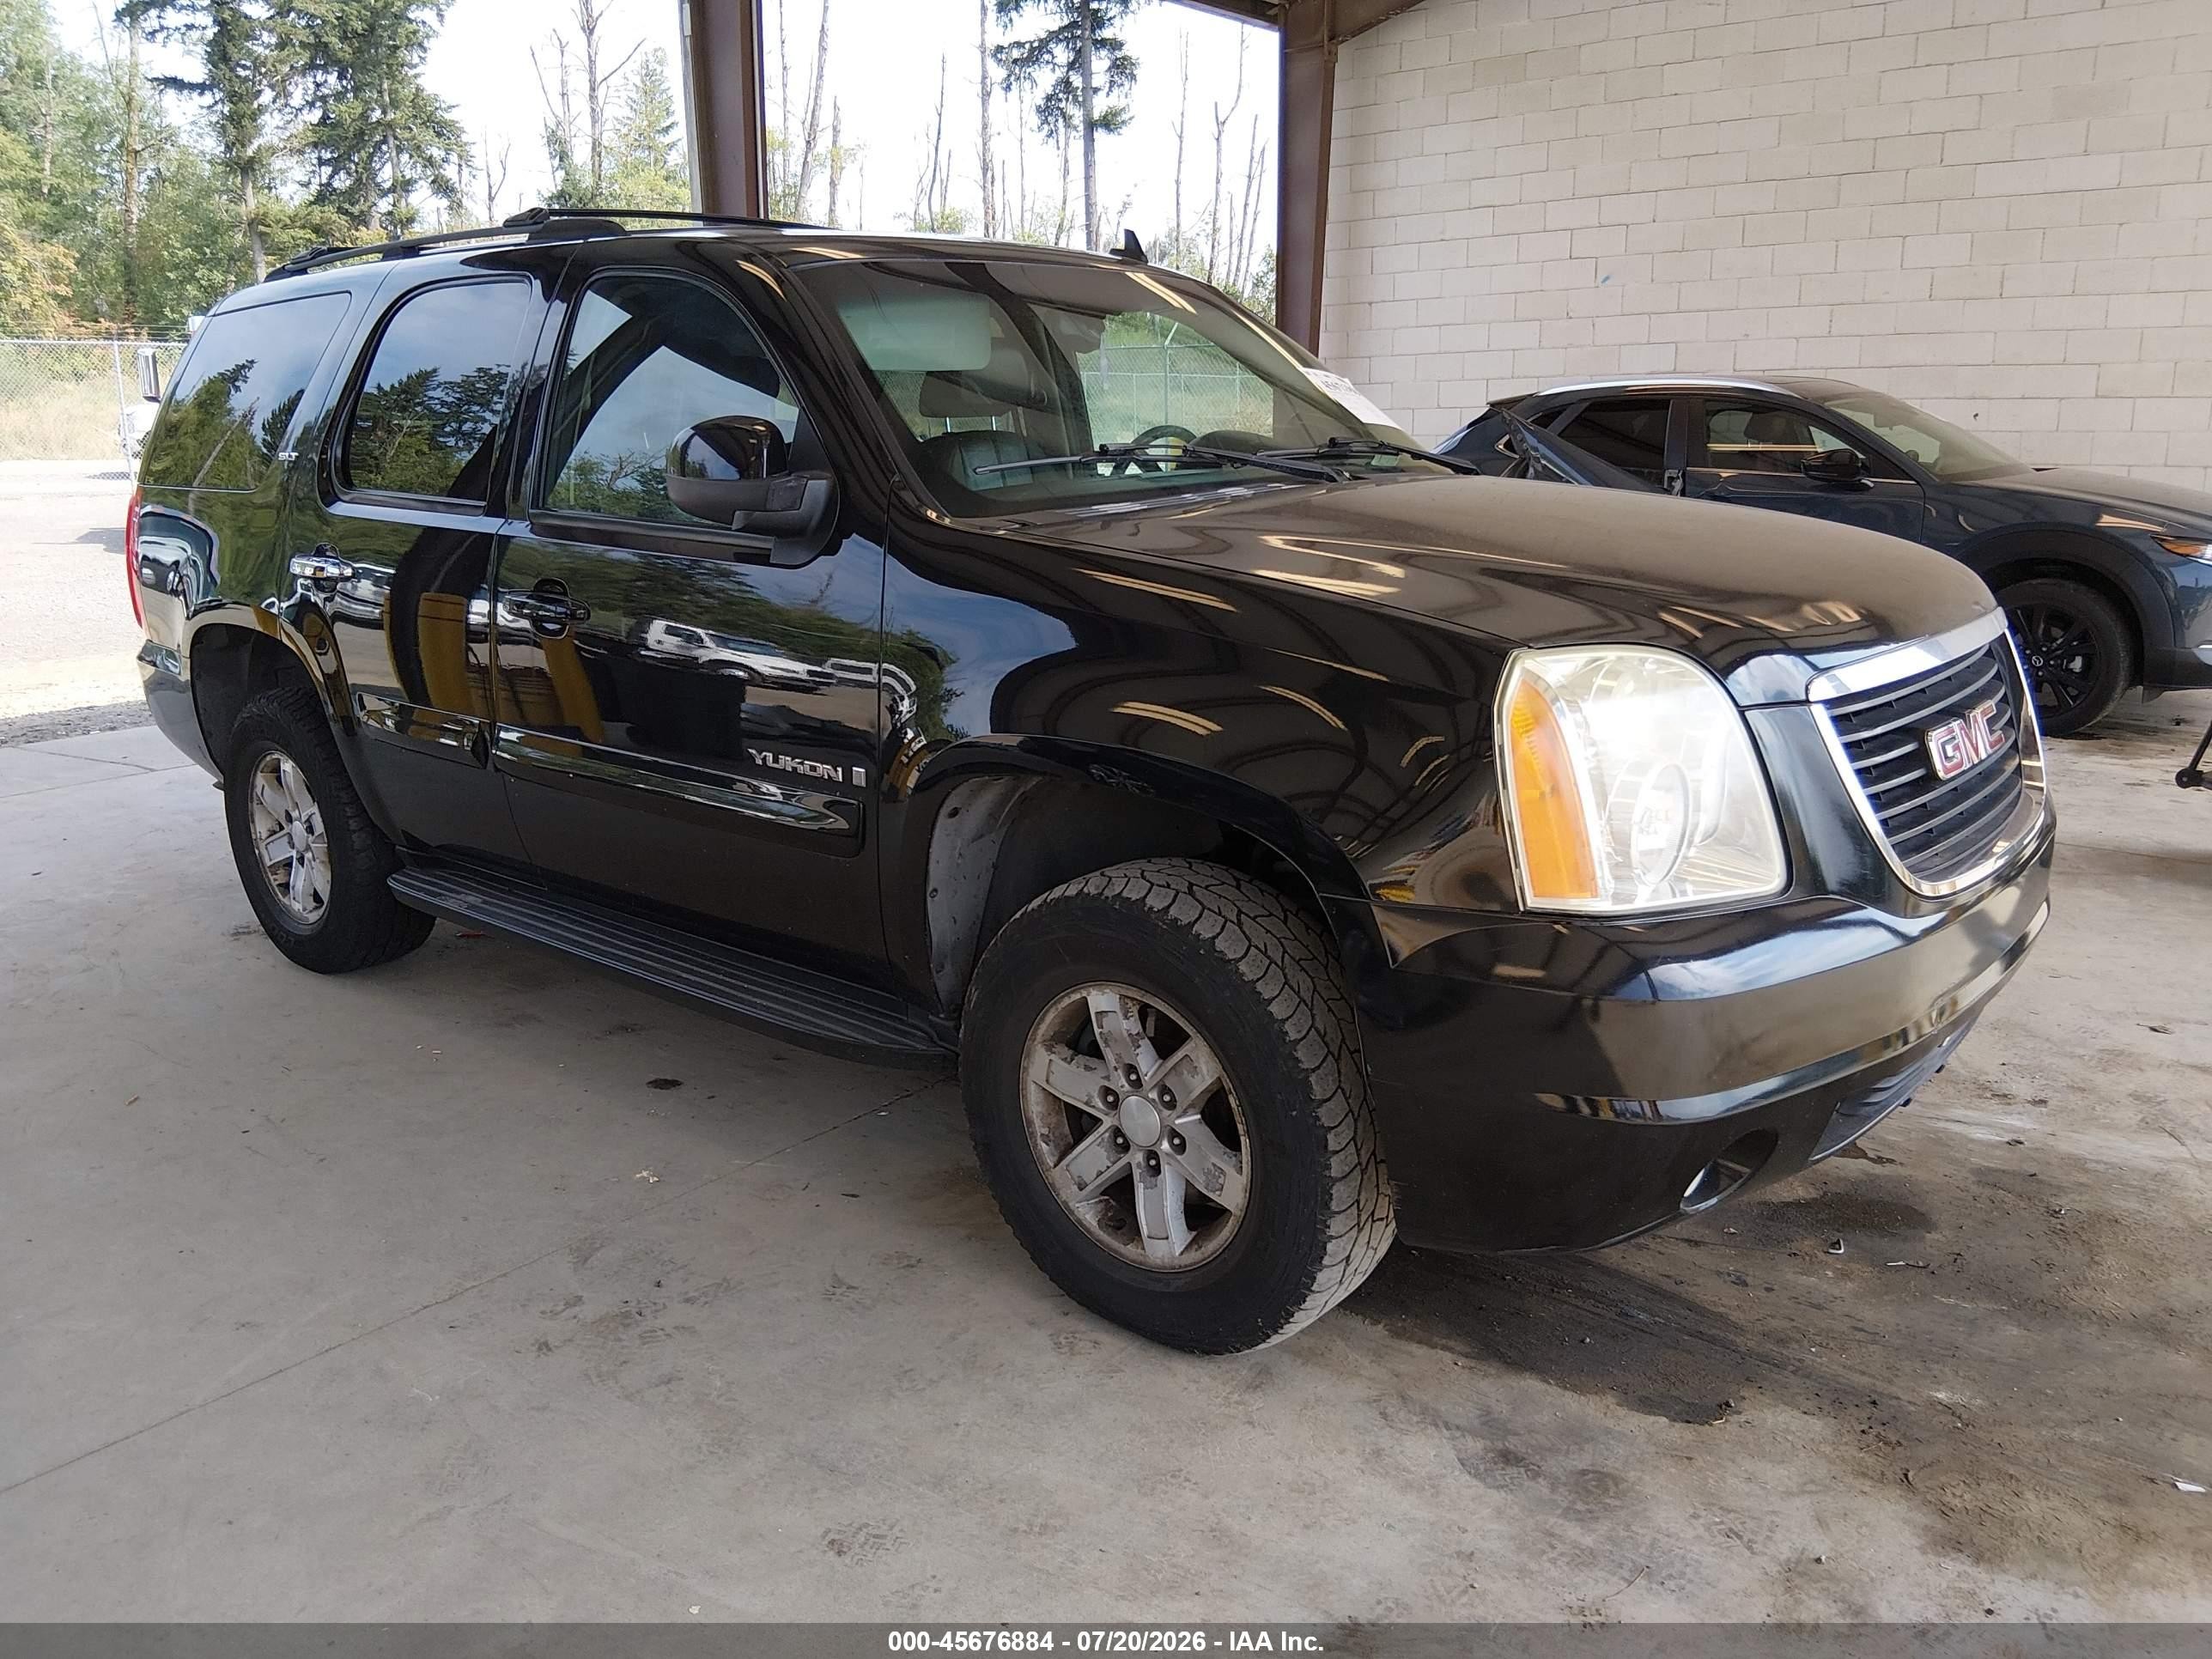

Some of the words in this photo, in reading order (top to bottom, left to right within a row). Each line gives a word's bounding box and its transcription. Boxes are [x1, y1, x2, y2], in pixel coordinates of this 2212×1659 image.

[278, 452, 299, 461] SLT
[1926, 699, 2005, 781] GMC
[747, 748, 843, 782] YUKON
